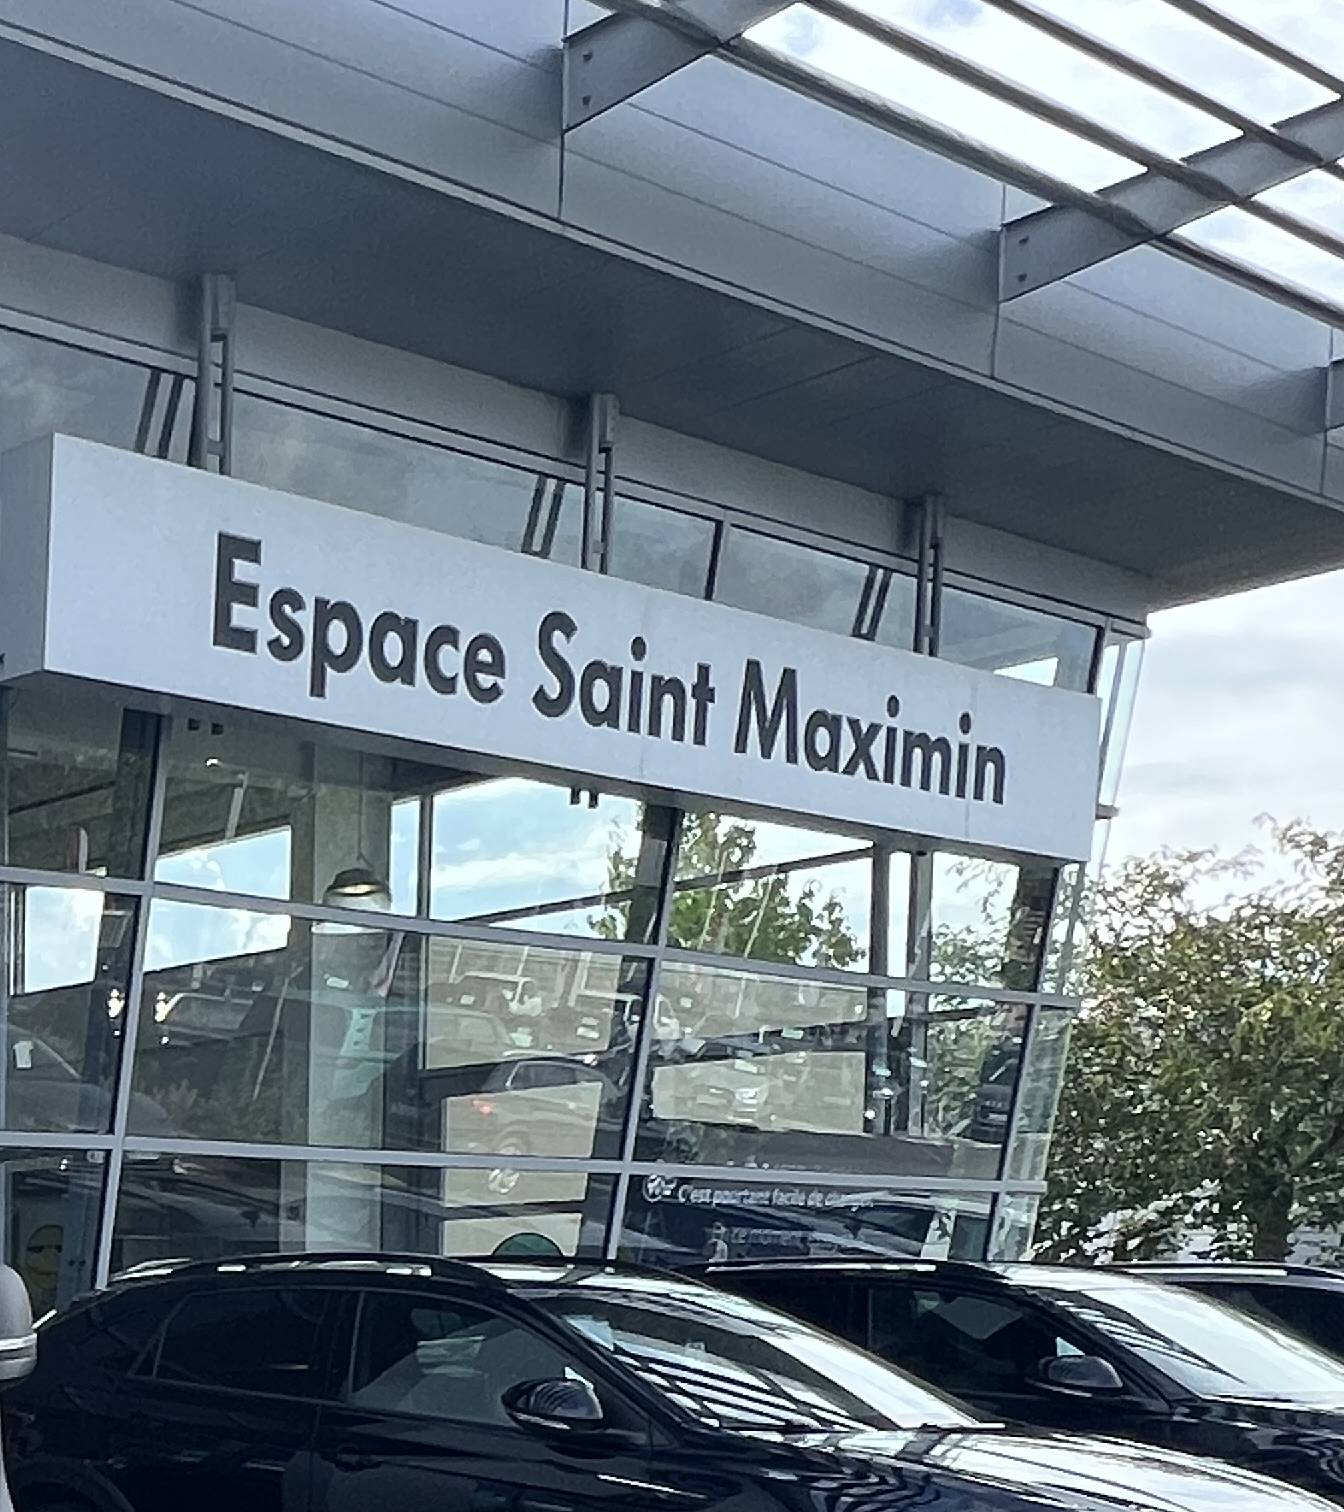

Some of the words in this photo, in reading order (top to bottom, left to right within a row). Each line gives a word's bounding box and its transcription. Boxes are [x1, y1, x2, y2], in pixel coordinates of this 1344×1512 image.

[212, 530, 506, 705] Espace
[531, 610, 716, 746] Saint
[733, 658, 1006, 805] Maximin
